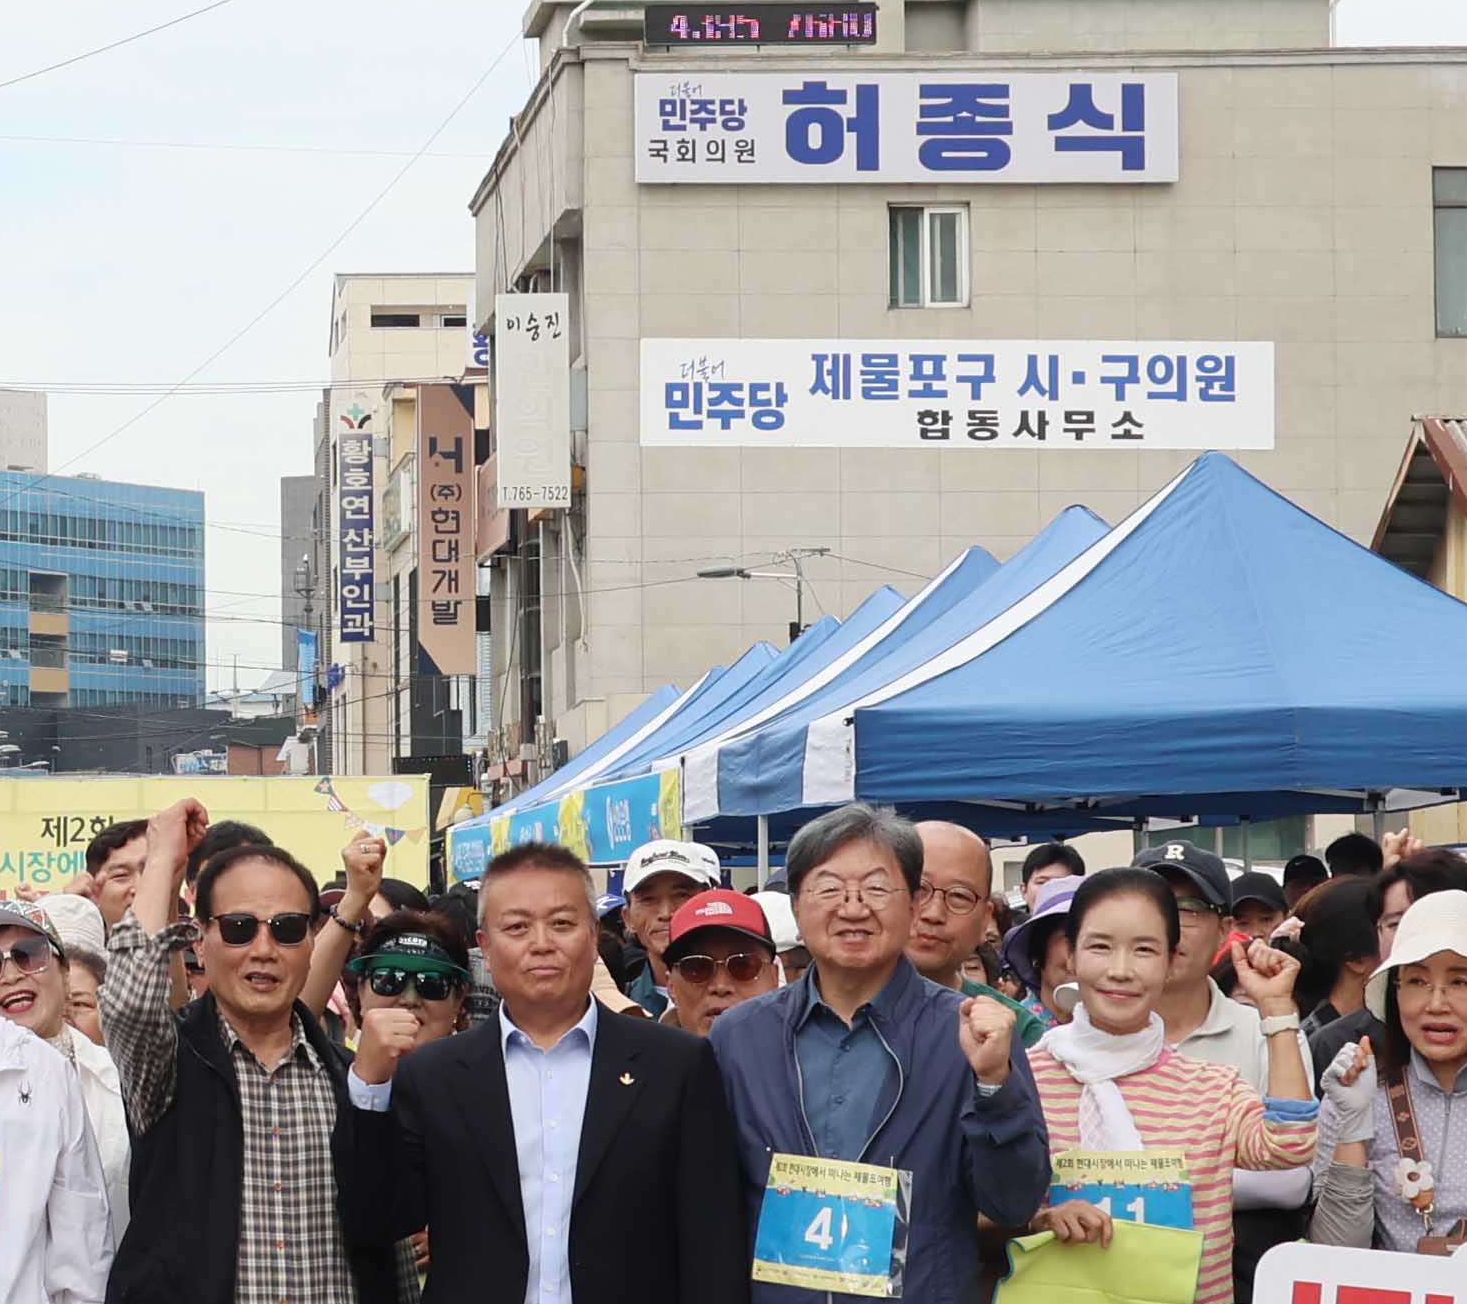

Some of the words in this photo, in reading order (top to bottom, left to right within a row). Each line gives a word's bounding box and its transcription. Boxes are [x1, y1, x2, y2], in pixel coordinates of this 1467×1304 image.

[660, 99, 747, 131] 민주당
[783, 82, 1145, 171] 허종식
[649, 139, 755, 163] 국회의원
[507, 313, 561, 341] 이승진
[809, 354, 995, 401] 제물포구
[665, 382, 787, 431] 민주당
[918, 410, 1143, 440] 합동사무소
[503, 486, 568, 501] T.765-7522
[342, 528, 373, 635] 산부인과
[805, 1207, 833, 1250] 4
